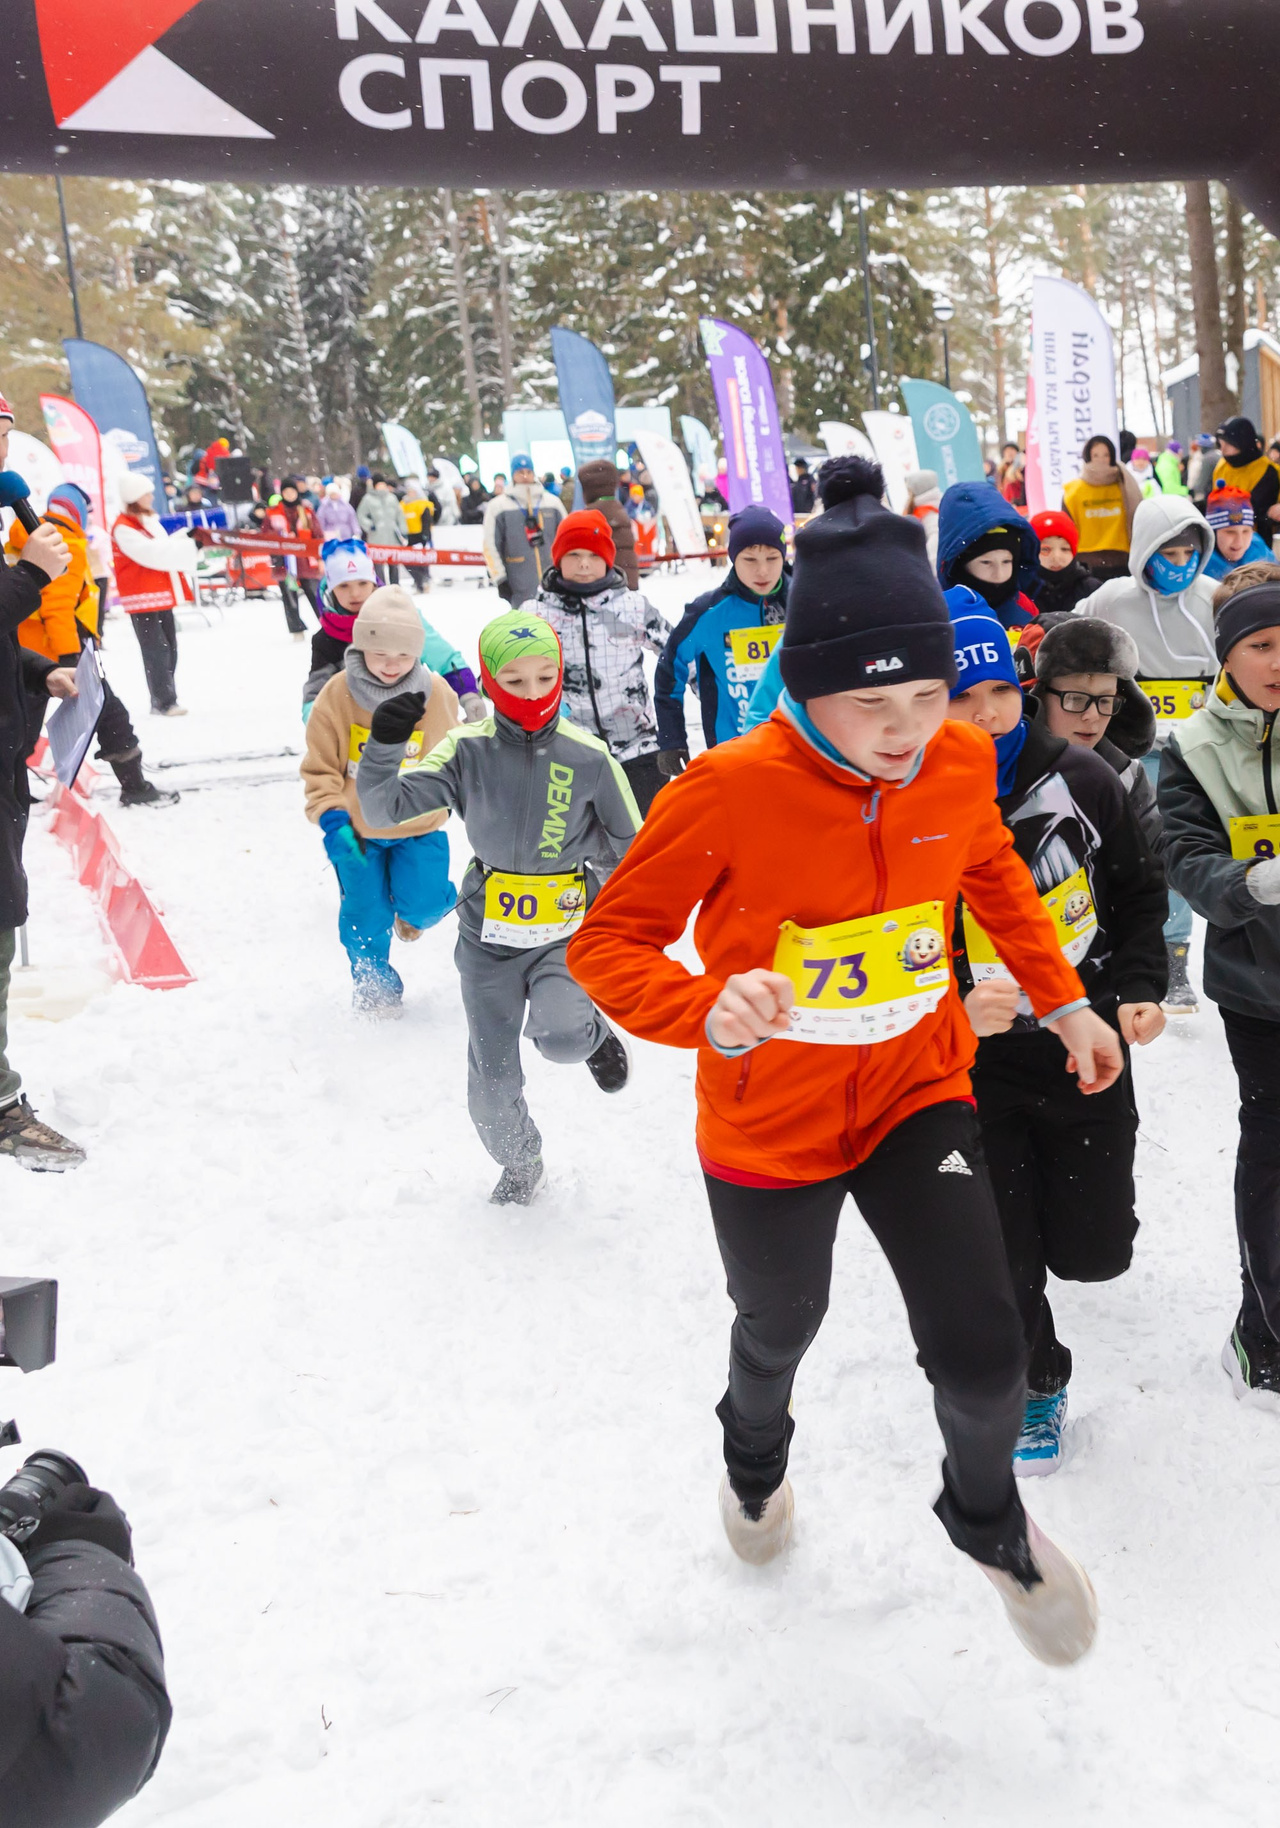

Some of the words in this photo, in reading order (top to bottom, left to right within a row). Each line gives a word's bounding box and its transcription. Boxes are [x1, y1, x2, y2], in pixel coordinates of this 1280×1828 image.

[335, 0, 1145, 56] КАЛАШНИКОВ
[338, 53, 721, 135] СПОРТ
[366, 546, 438, 565] ПОРТИВНЫЙ
[747, 640, 770, 660] 81
[864, 656, 905, 675] FILA
[538, 762, 575, 854] DEMIX
[540, 850, 559, 859] TEAM
[498, 891, 538, 921] 90
[802, 951, 869, 1000] 73
[938, 1164, 973, 1177] adidas
